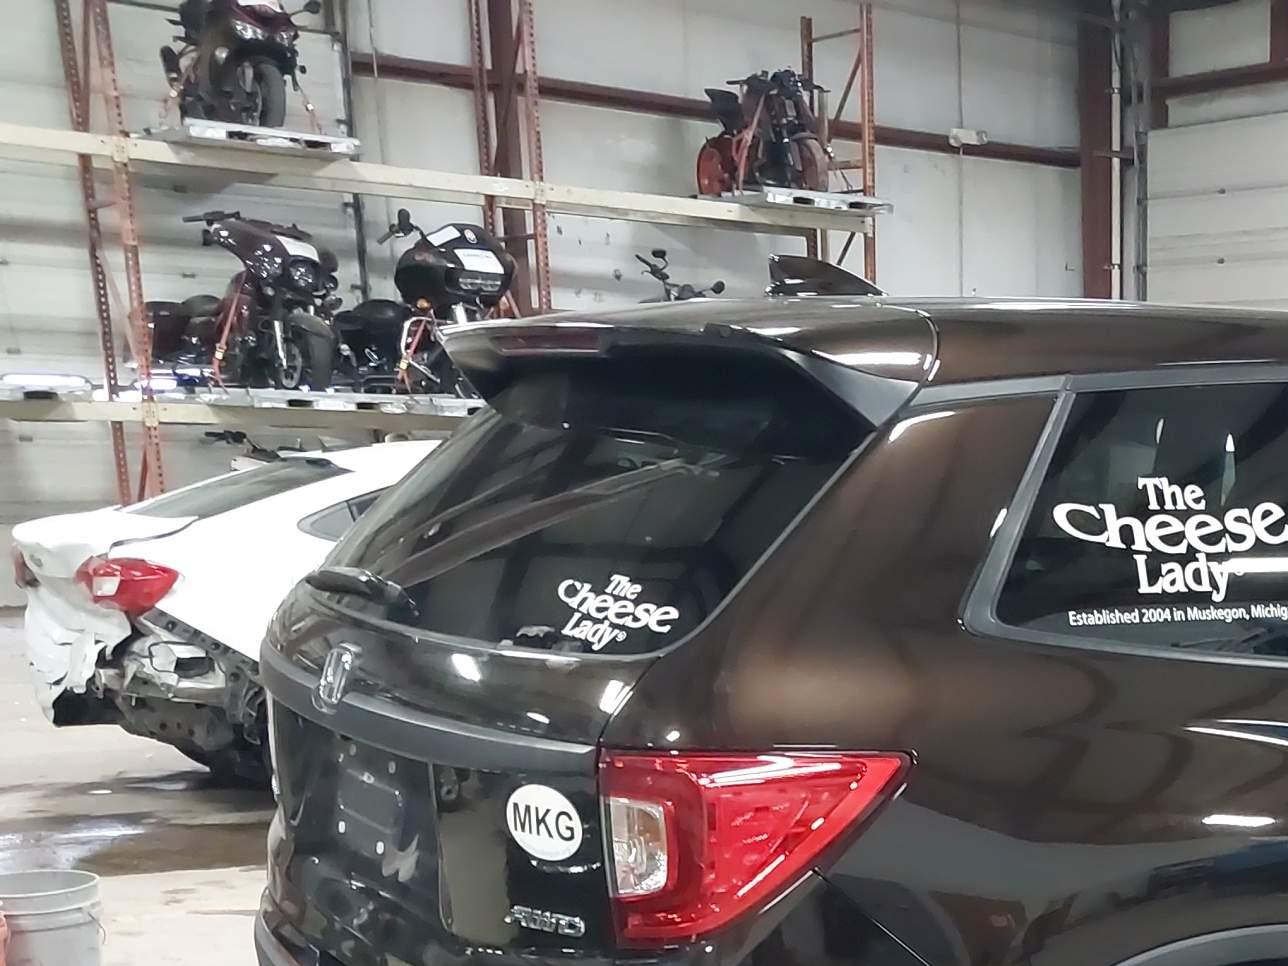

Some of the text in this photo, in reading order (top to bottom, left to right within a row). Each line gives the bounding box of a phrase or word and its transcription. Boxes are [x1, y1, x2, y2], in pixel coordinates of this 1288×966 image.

[1137, 476, 1206, 511] The
[604, 573, 642, 600] The
[558, 579, 680, 633] Cheese
[1068, 608, 1140, 626] Established
[1142, 609, 1172, 623] 2004
[1173, 608, 1186, 622] in
[1187, 605, 1250, 623] Muskegon,
[512, 802, 575, 842] MKG
